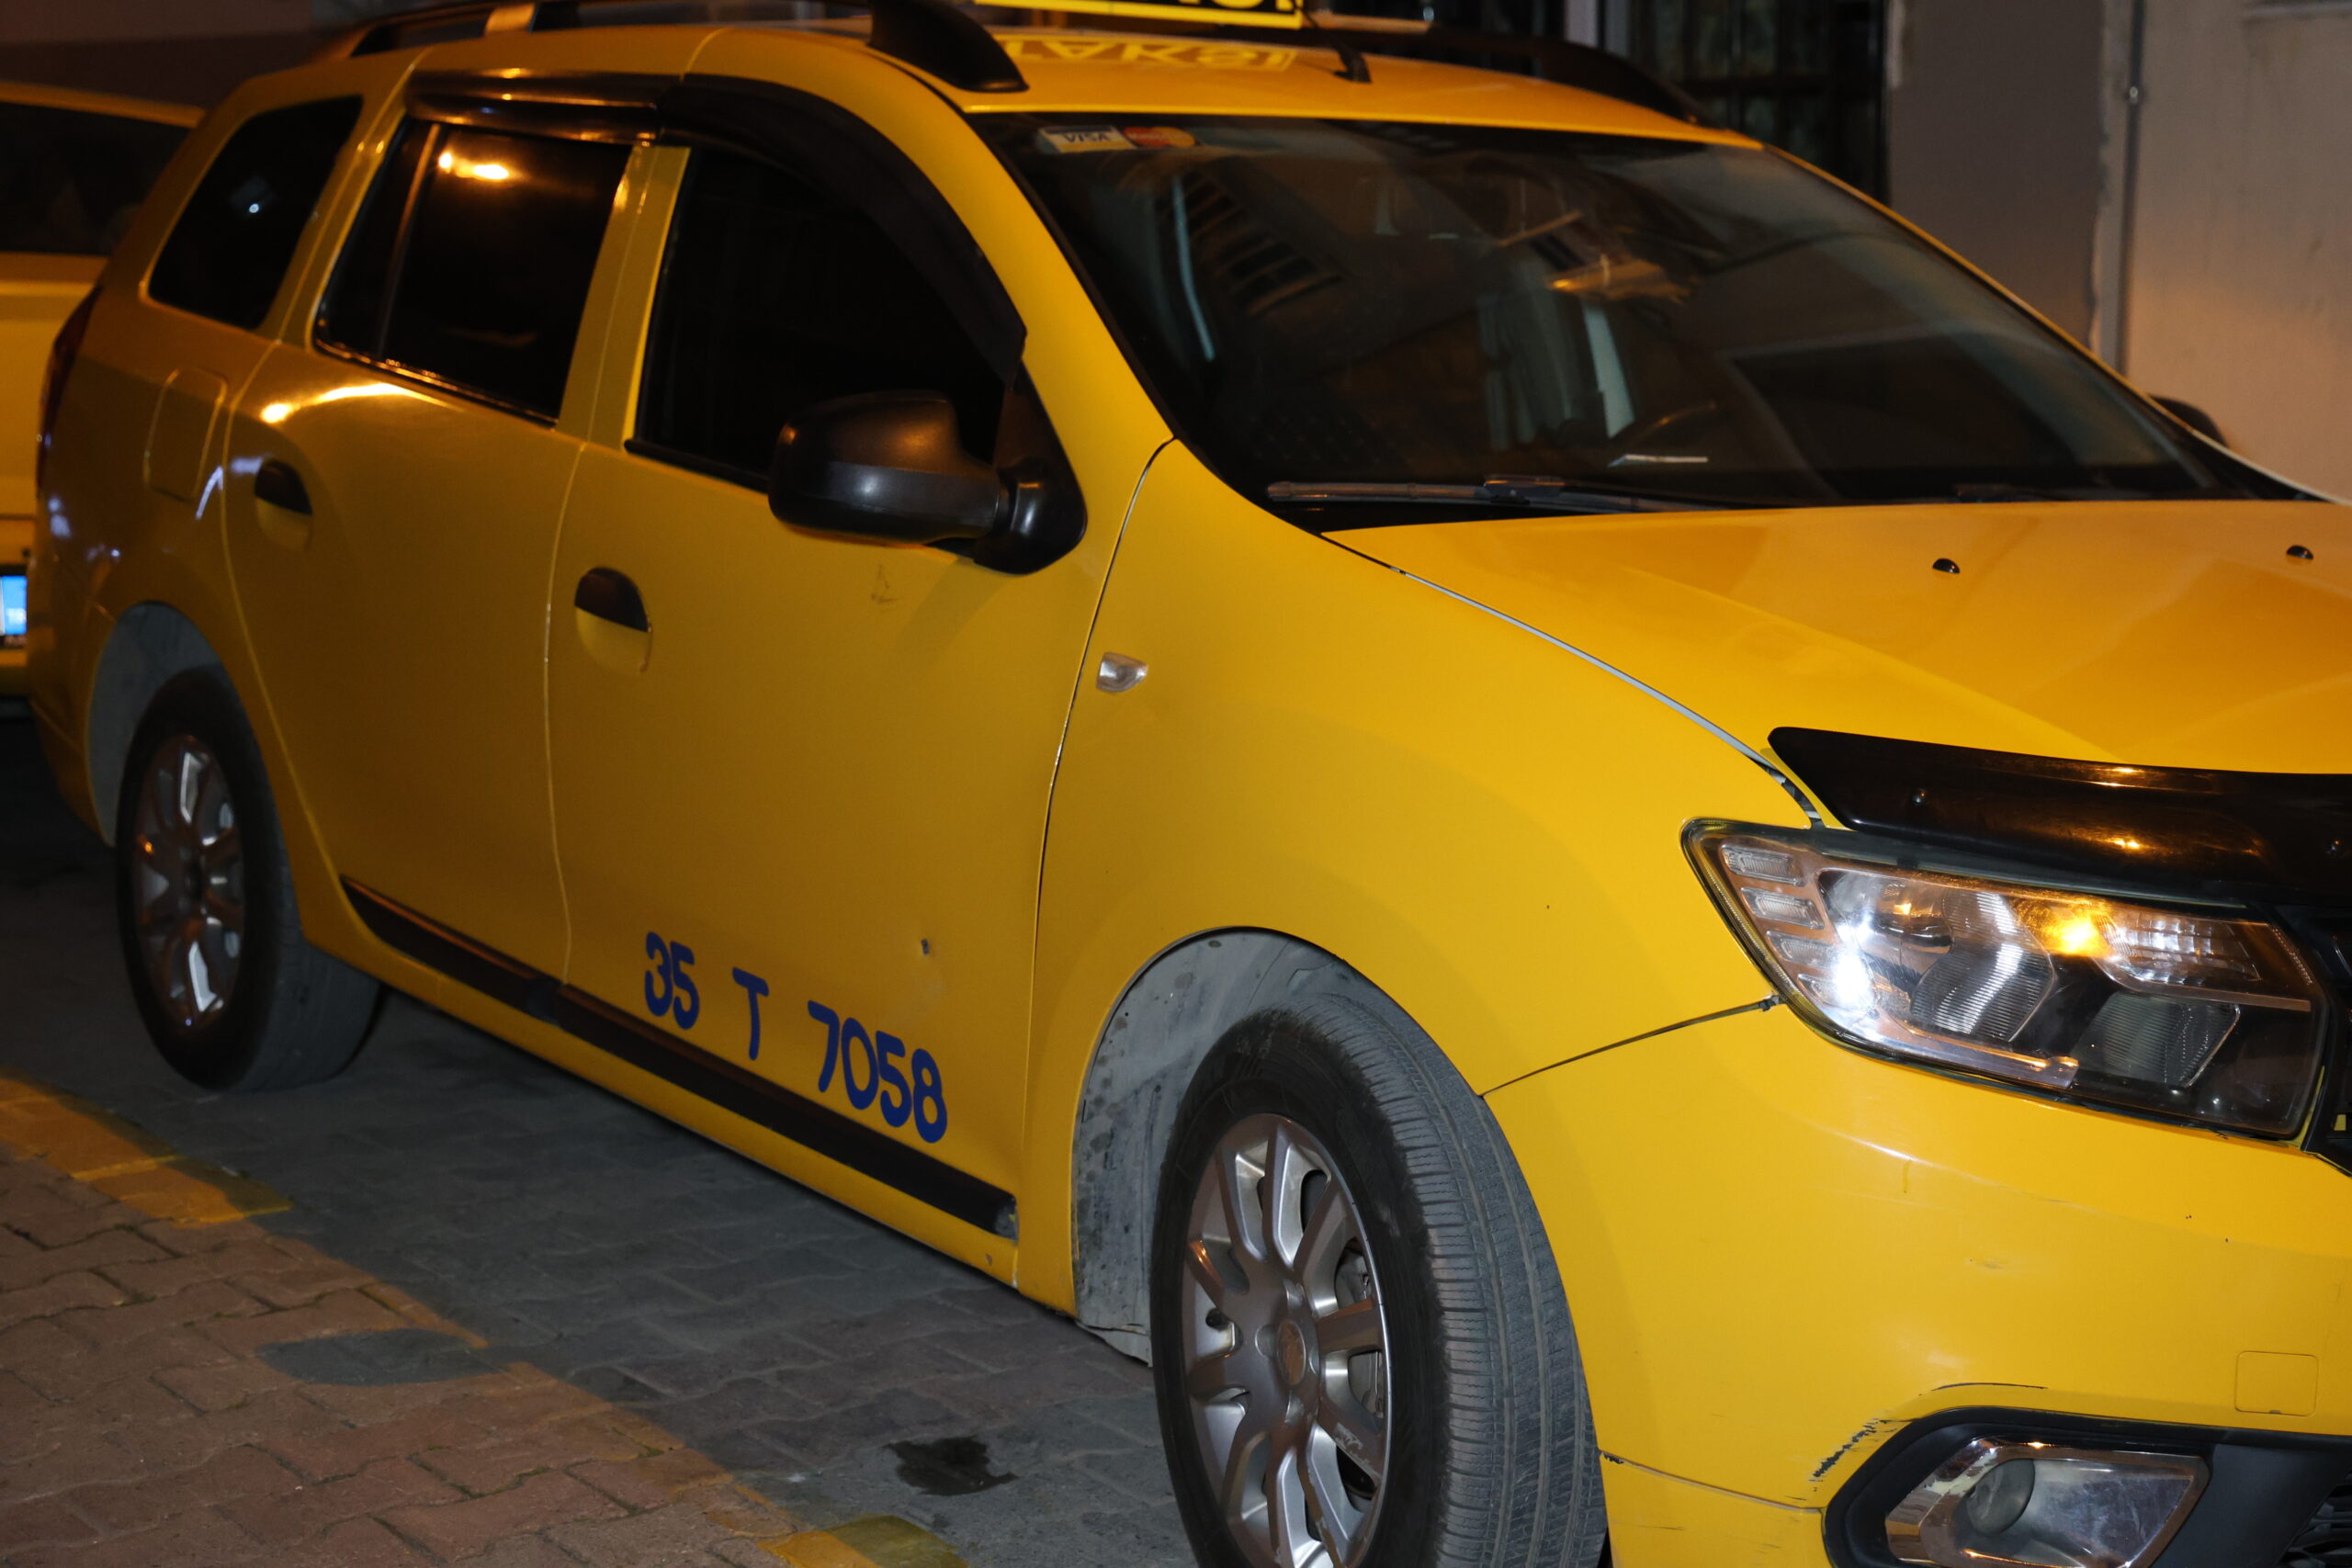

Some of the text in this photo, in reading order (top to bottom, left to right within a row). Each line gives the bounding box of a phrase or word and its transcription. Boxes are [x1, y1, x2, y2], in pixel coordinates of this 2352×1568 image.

[1063, 132, 1111, 142] VISA
[645, 931, 948, 1144] 35 T 7058
